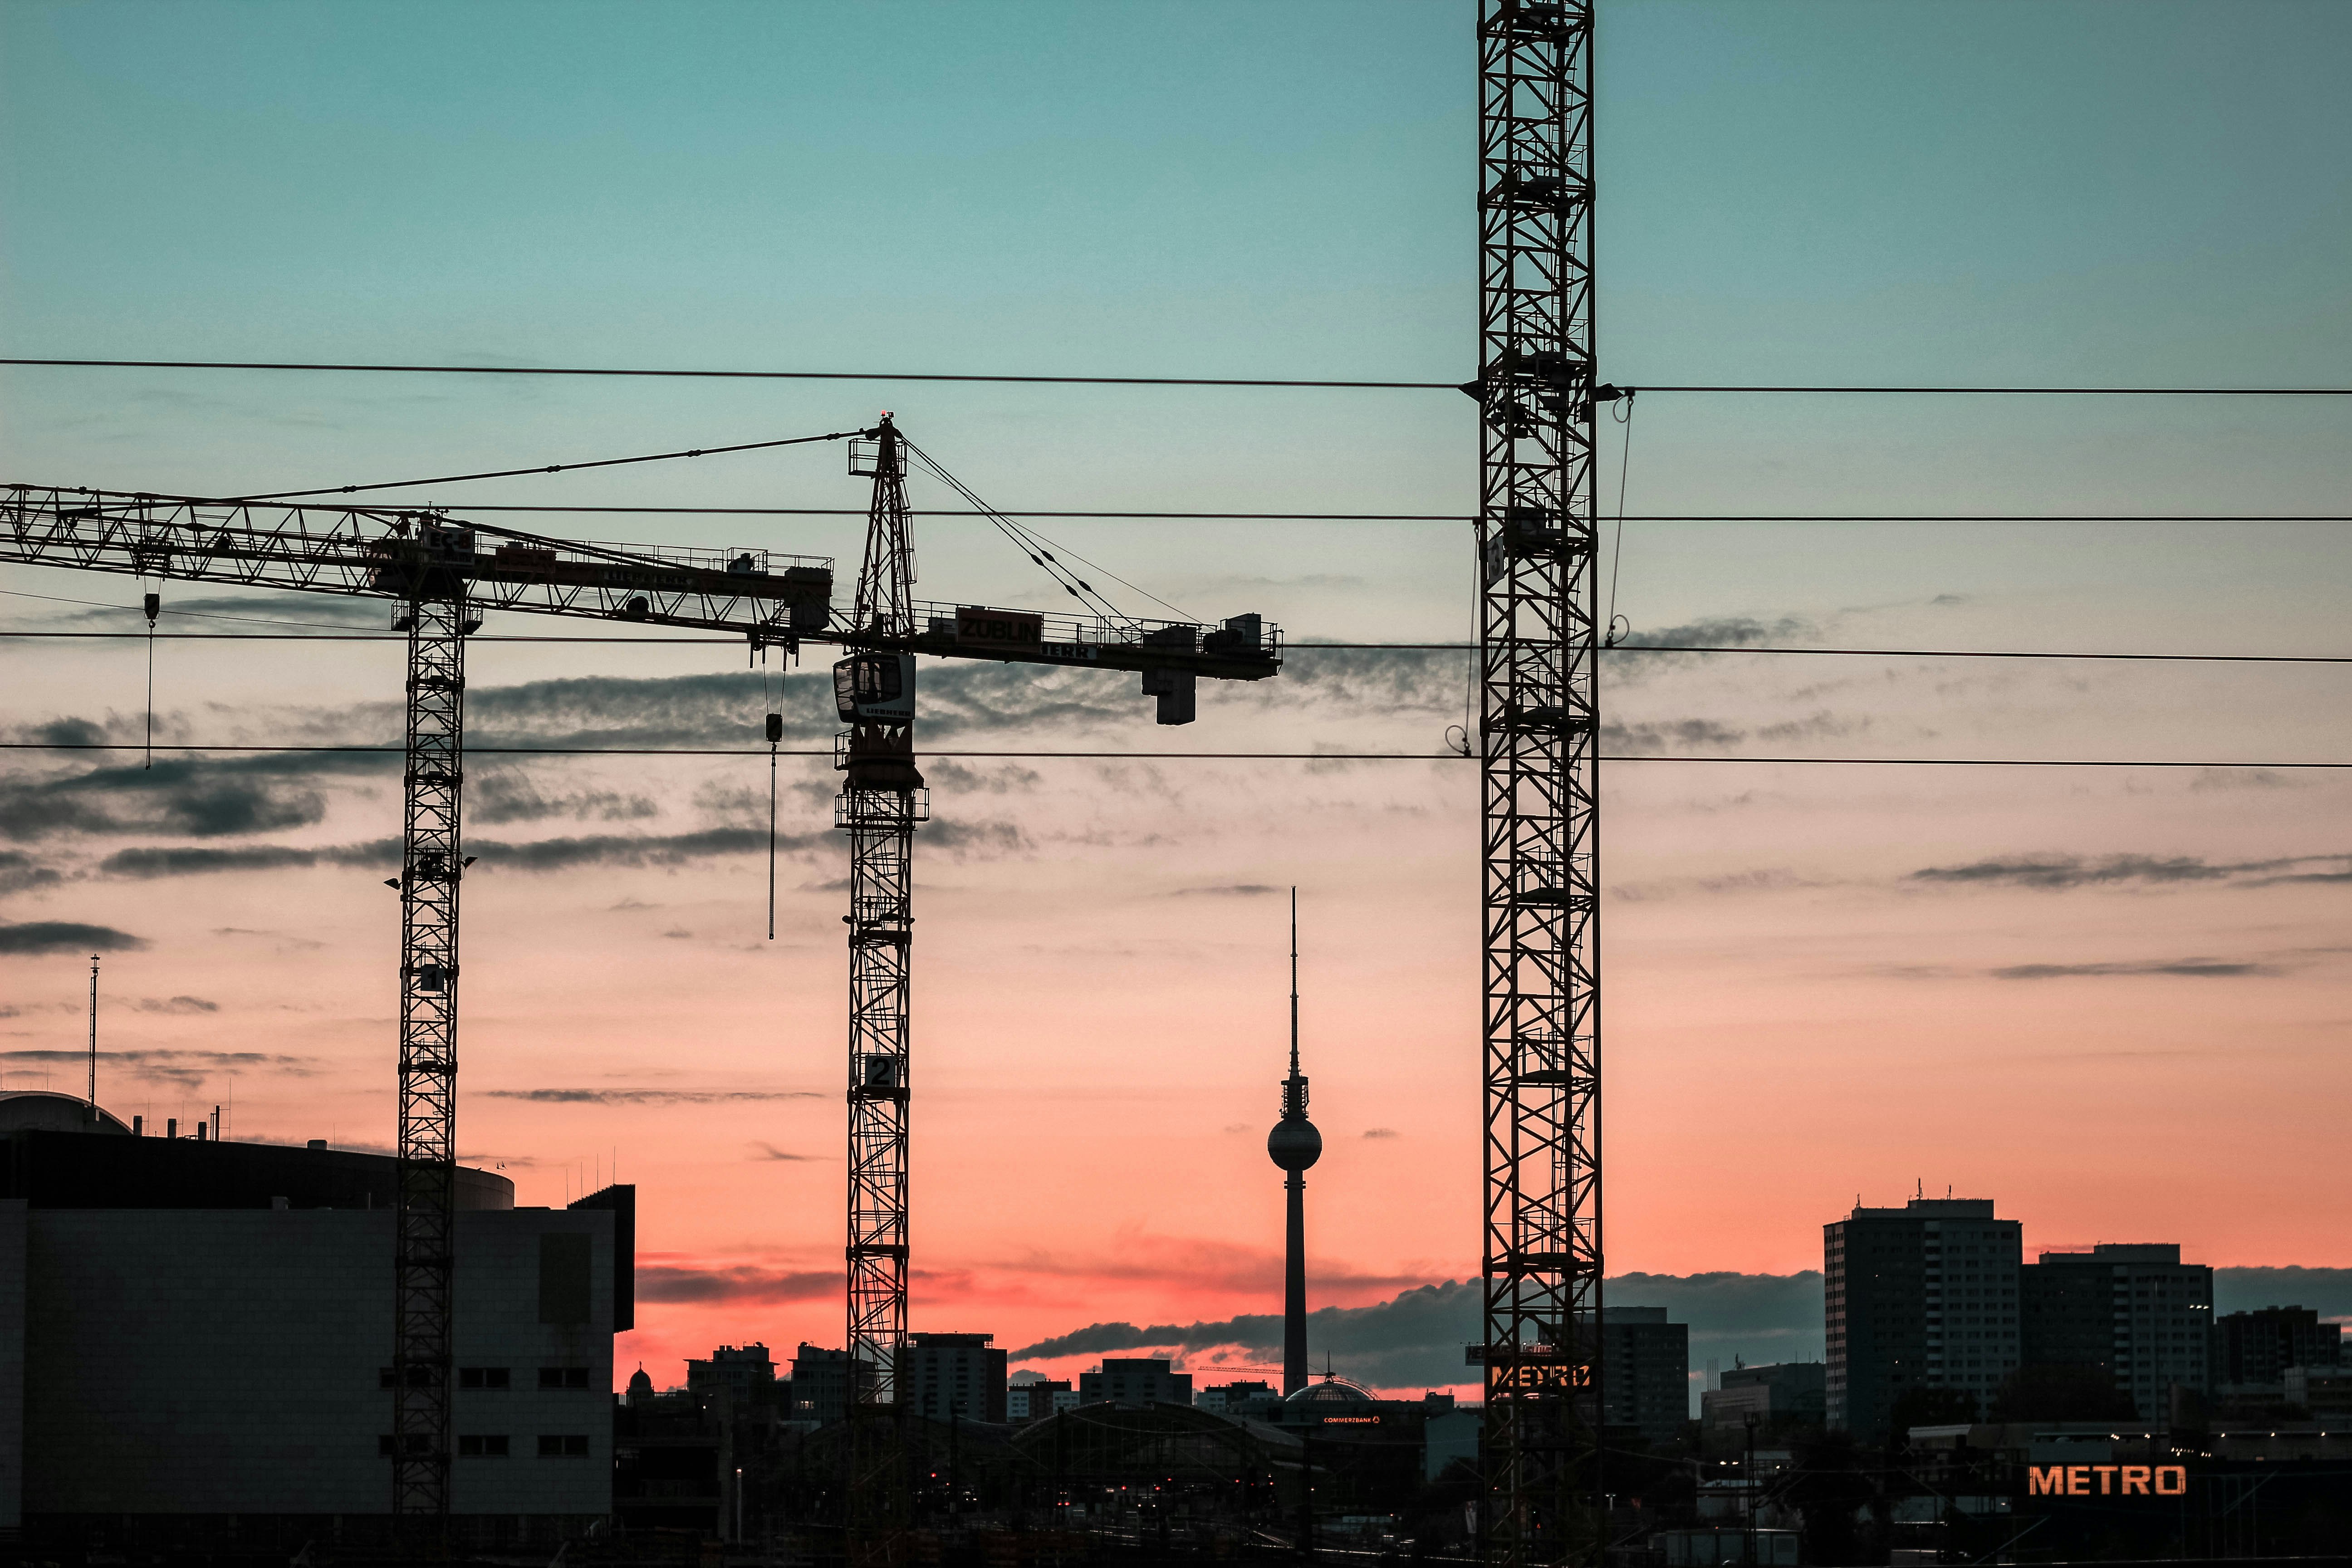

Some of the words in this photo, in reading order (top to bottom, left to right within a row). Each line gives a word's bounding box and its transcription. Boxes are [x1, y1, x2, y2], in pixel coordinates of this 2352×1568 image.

[867, 708, 911, 717] LIEBHERR
[428, 971, 436, 989] 1
[871, 1058, 890, 1085] 2
[2029, 1465, 2187, 1495] METRO
